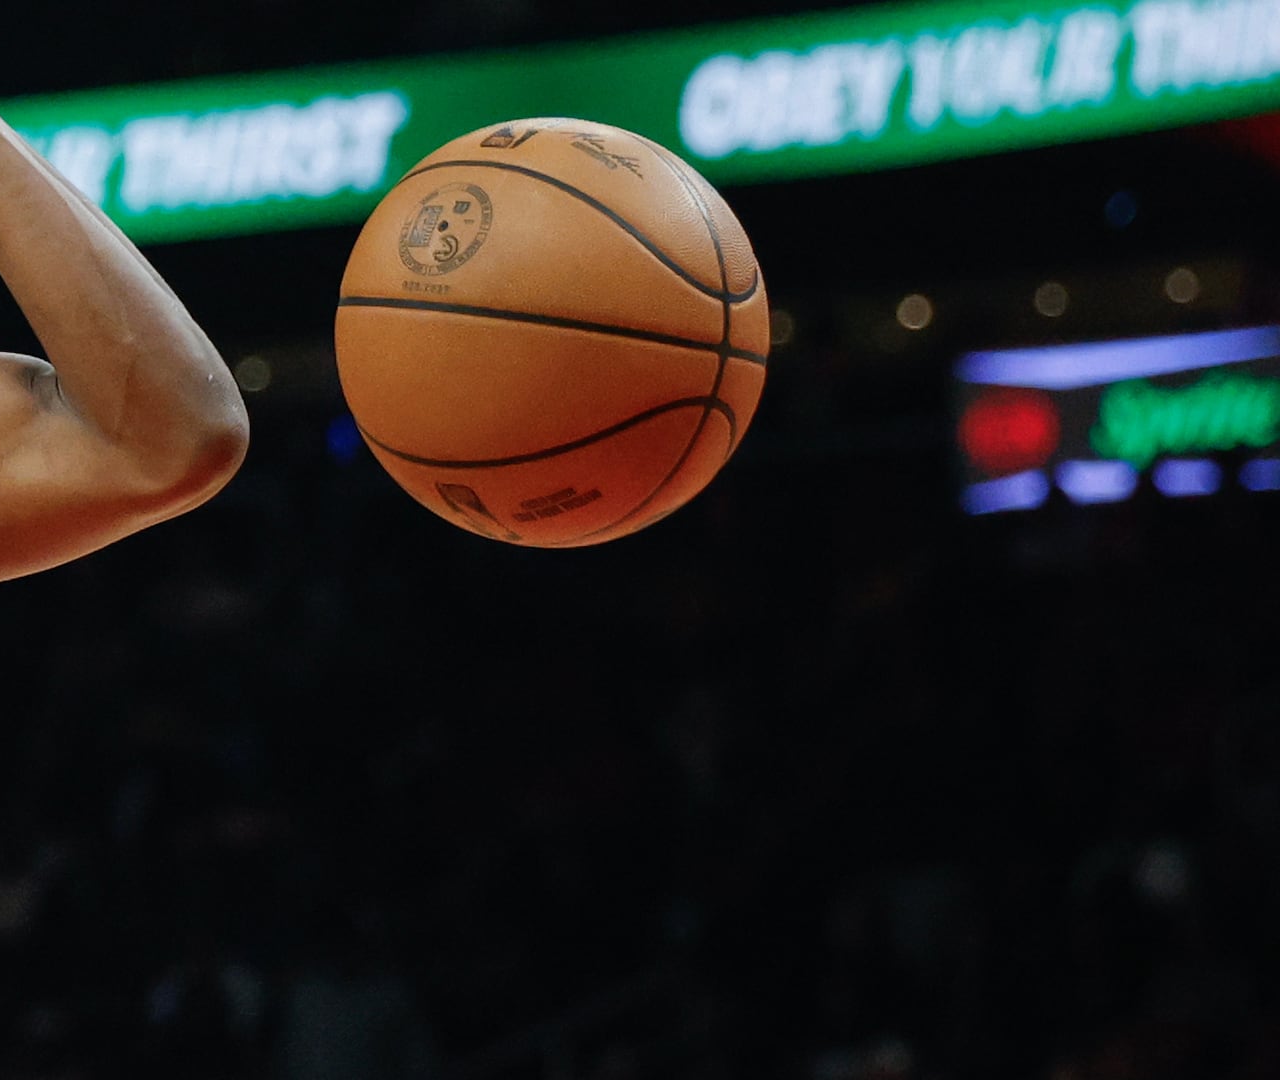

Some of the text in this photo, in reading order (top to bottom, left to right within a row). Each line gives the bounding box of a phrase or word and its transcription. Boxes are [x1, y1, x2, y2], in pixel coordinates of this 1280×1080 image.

[679, 40, 906, 158] OBEY
[906, 12, 1121, 130] YOUR
[120, 92, 408, 215] THIRST
